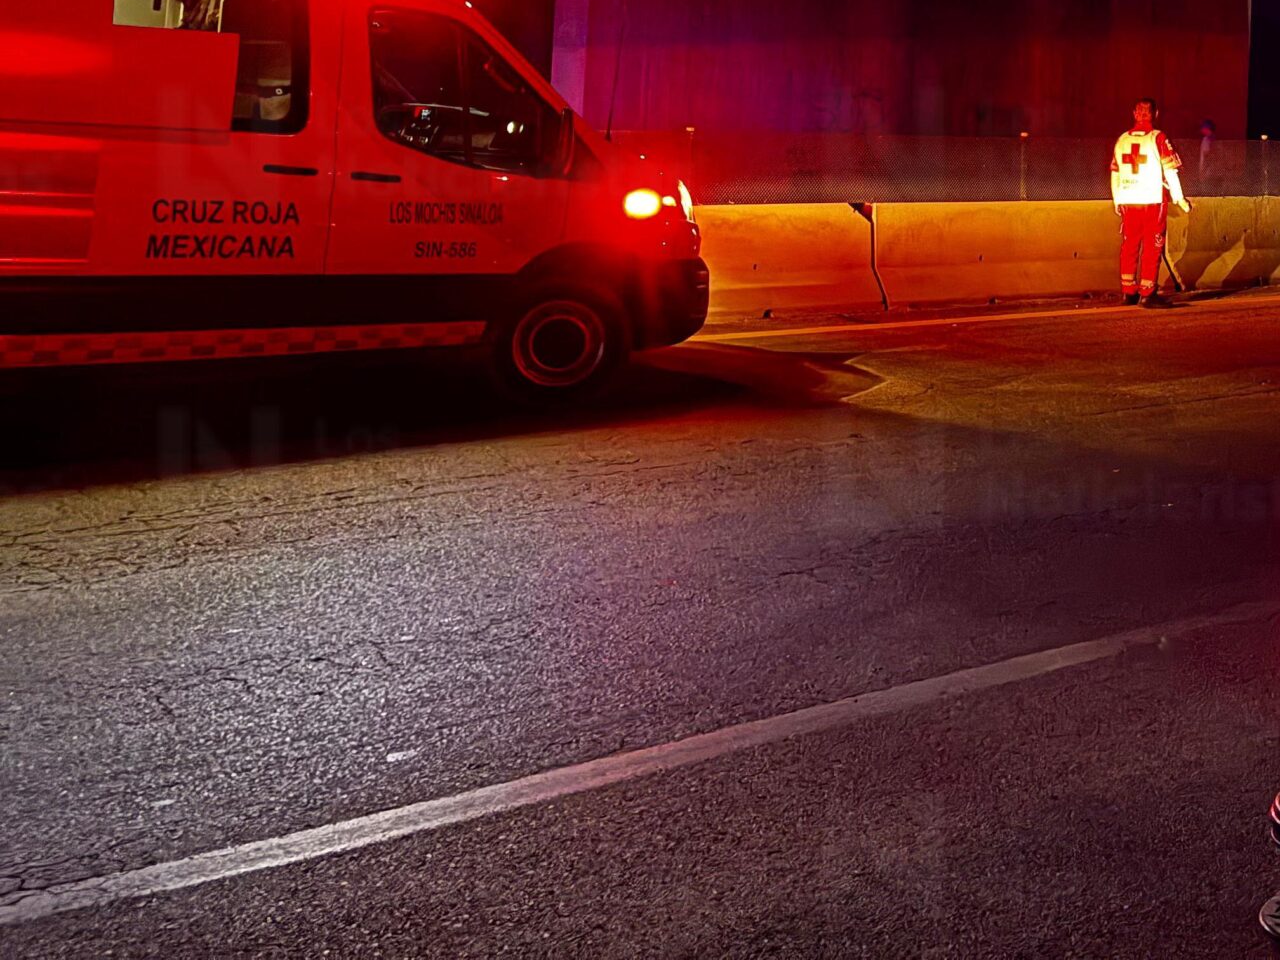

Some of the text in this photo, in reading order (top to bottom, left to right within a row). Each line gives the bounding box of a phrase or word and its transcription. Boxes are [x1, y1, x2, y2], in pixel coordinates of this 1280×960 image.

[153, 199, 300, 225] CRUZ ROJA
[389, 201, 504, 225] LOS MOCHIS SINALOA
[145, 234, 295, 258] MEXICANA
